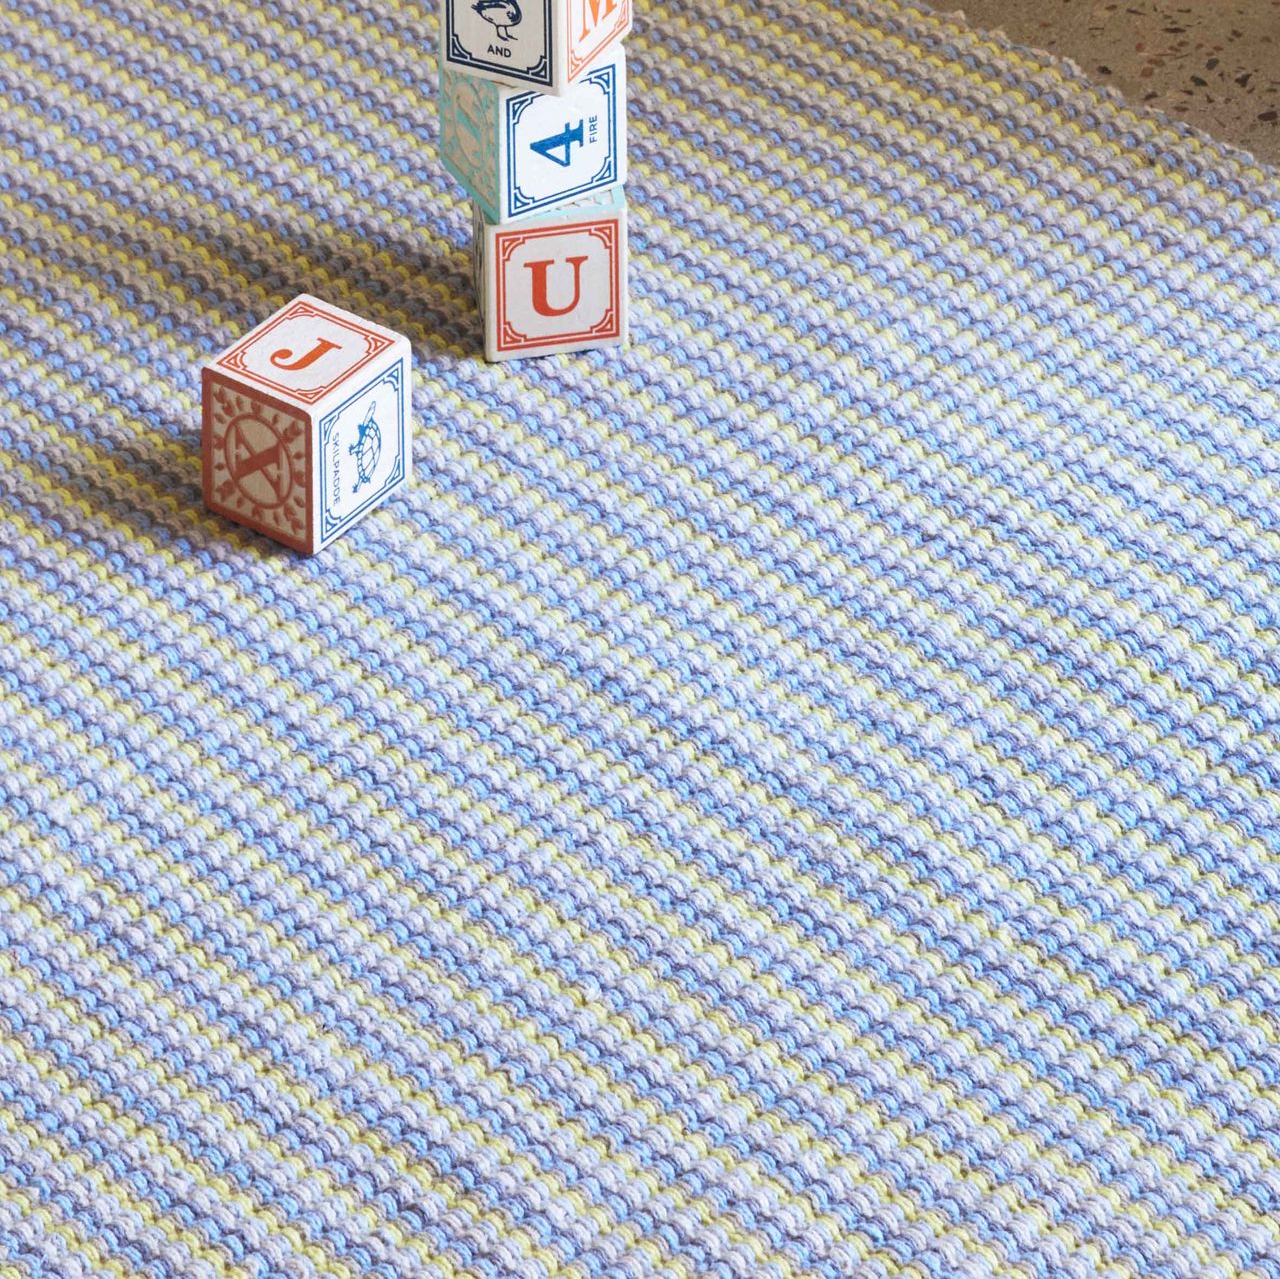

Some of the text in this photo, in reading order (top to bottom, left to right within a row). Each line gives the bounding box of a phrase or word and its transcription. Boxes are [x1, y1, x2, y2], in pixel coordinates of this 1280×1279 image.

[487, 43, 512, 59] AND
[530, 118, 584, 167] 4
[589, 115, 598, 144] FIRE
[523, 255, 589, 317] U
[269, 337, 343, 371] J
